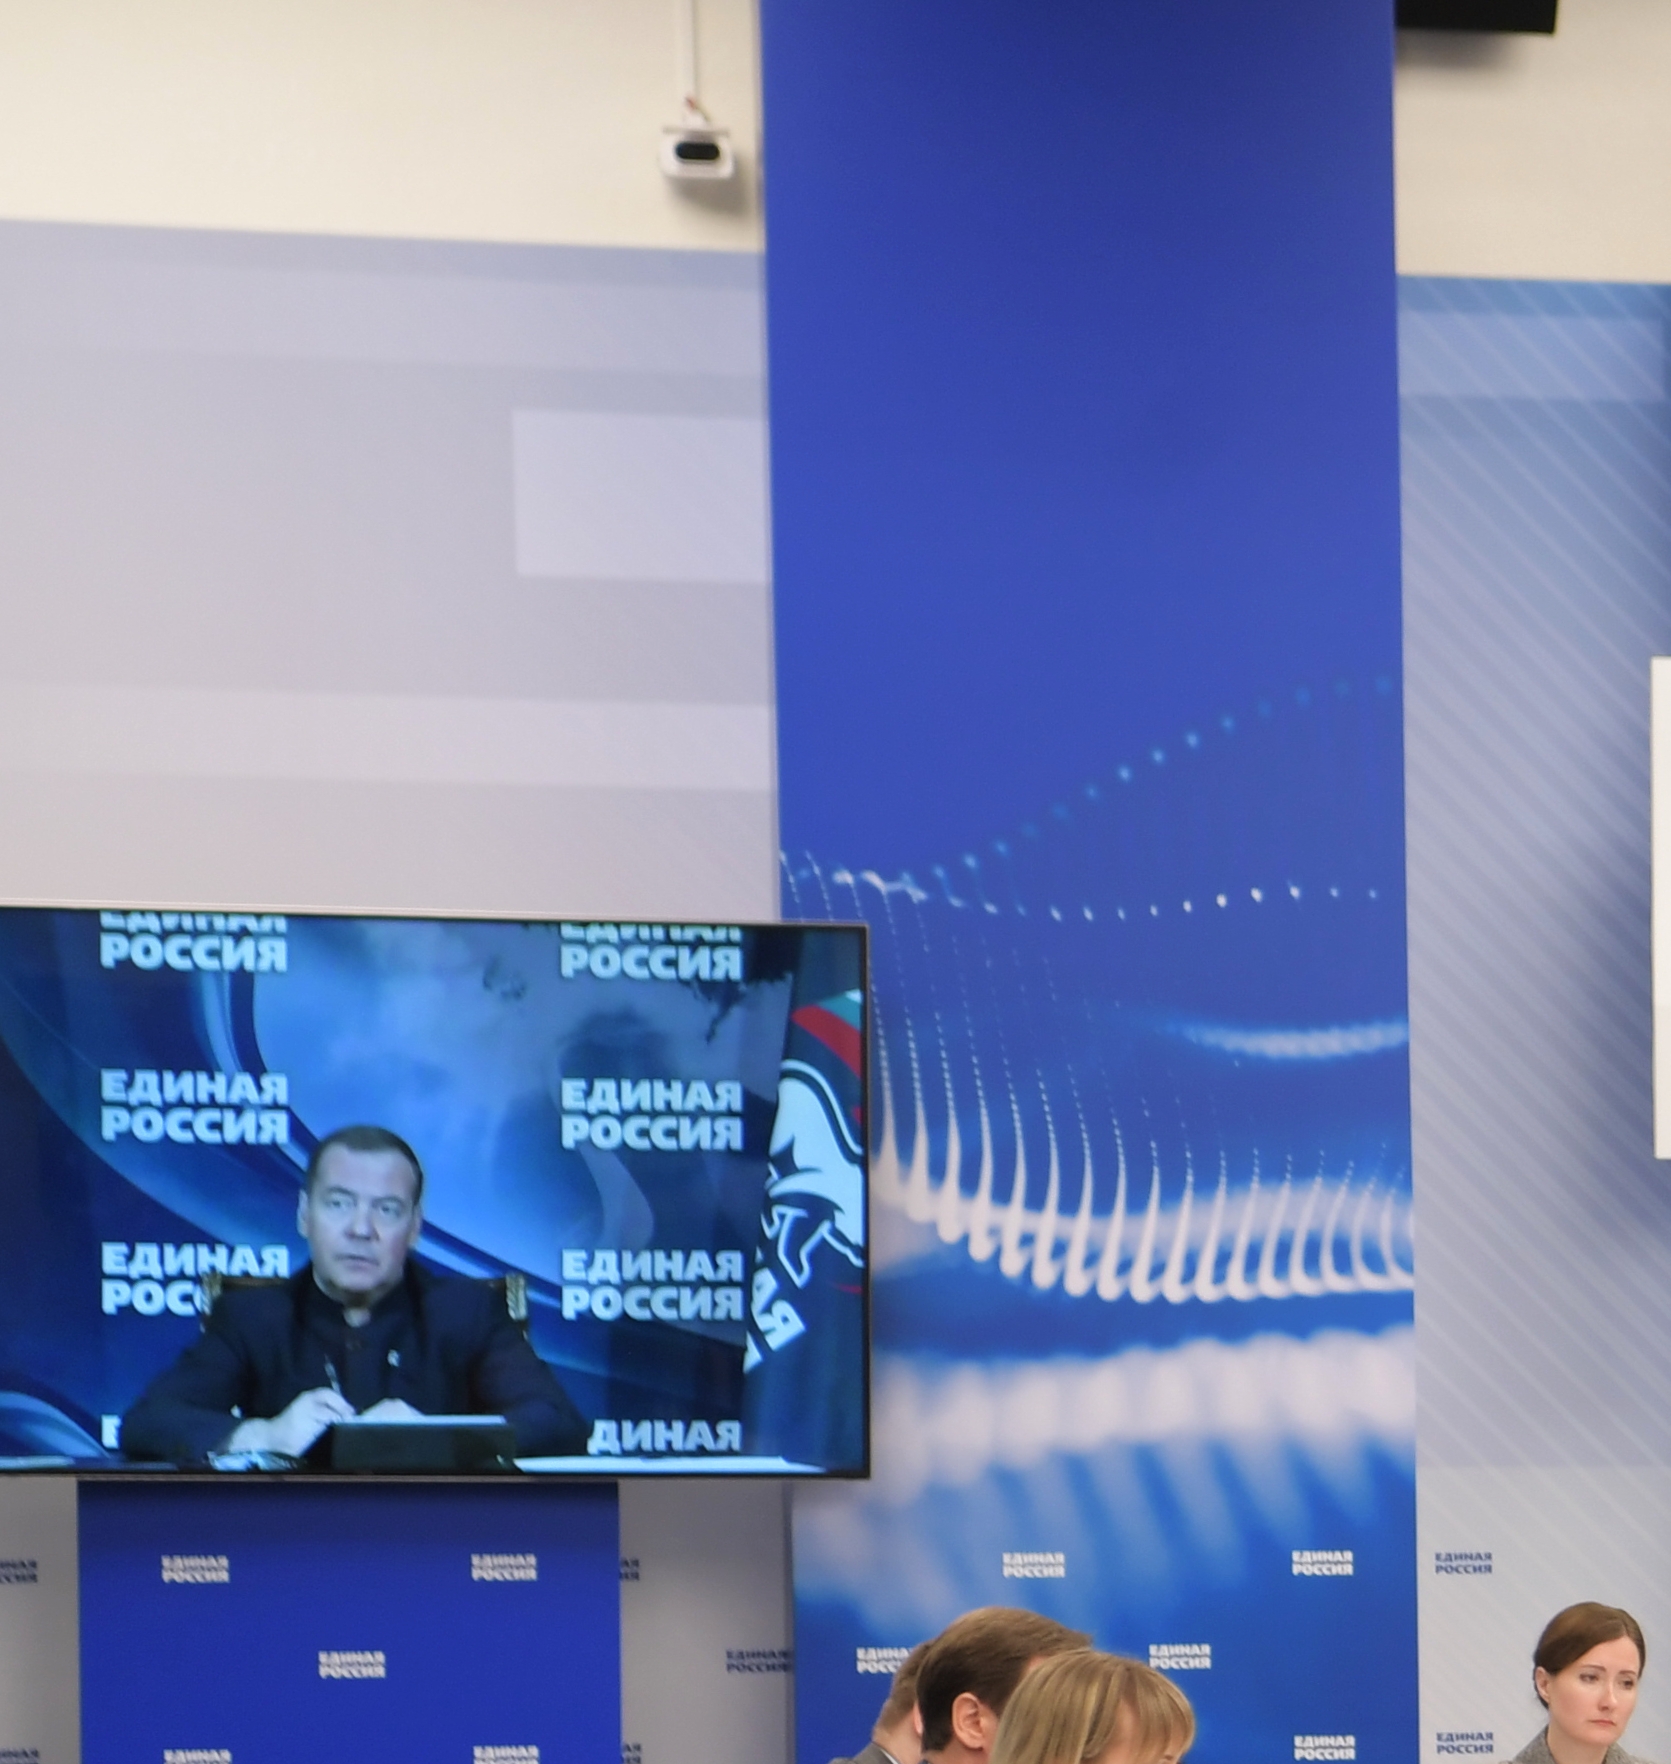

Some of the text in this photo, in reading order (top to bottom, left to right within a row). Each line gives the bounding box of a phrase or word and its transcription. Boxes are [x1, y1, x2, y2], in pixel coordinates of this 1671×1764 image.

[100, 932, 288, 972] РОССИЯ
[560, 943, 743, 981] РОССИЯ
[100, 1068, 289, 1107] ЕДИНАЯ
[561, 1077, 743, 1114] ЕДИНАЯ
[101, 1105, 290, 1144] РОССИЯ
[561, 1114, 743, 1151] РОССИЯ
[562, 1249, 744, 1285] ЕДИНАЯ
[101, 1278, 204, 1317] РОС
[562, 1285, 744, 1321] РОССИЯ
[587, 1419, 742, 1455] ДИНАЯ
[1002, 1552, 1066, 1565] ЕДИНАЯ
[1291, 1550, 1354, 1563] ЕДИНАЯ
[1434, 1552, 1493, 1564] ЕДИНАЯ
[1002, 1564, 1066, 1578] РОССИЯ
[1291, 1562, 1354, 1576] РОССИЯ
[1434, 1563, 1493, 1575] РОССИЯ
[857, 1647, 913, 1661] ЕДИНА
[1148, 1643, 1212, 1657] ЕДИНАЯ
[1149, 1656, 1213, 1670] РОССИЯ
[1293, 1735, 1356, 1748] ЕДИНАЯ
[1436, 1732, 1494, 1744] ЕДИНАЯ
[1294, 1747, 1356, 1761] РОССИЯ
[1436, 1743, 1494, 1755] РОССИЯ
